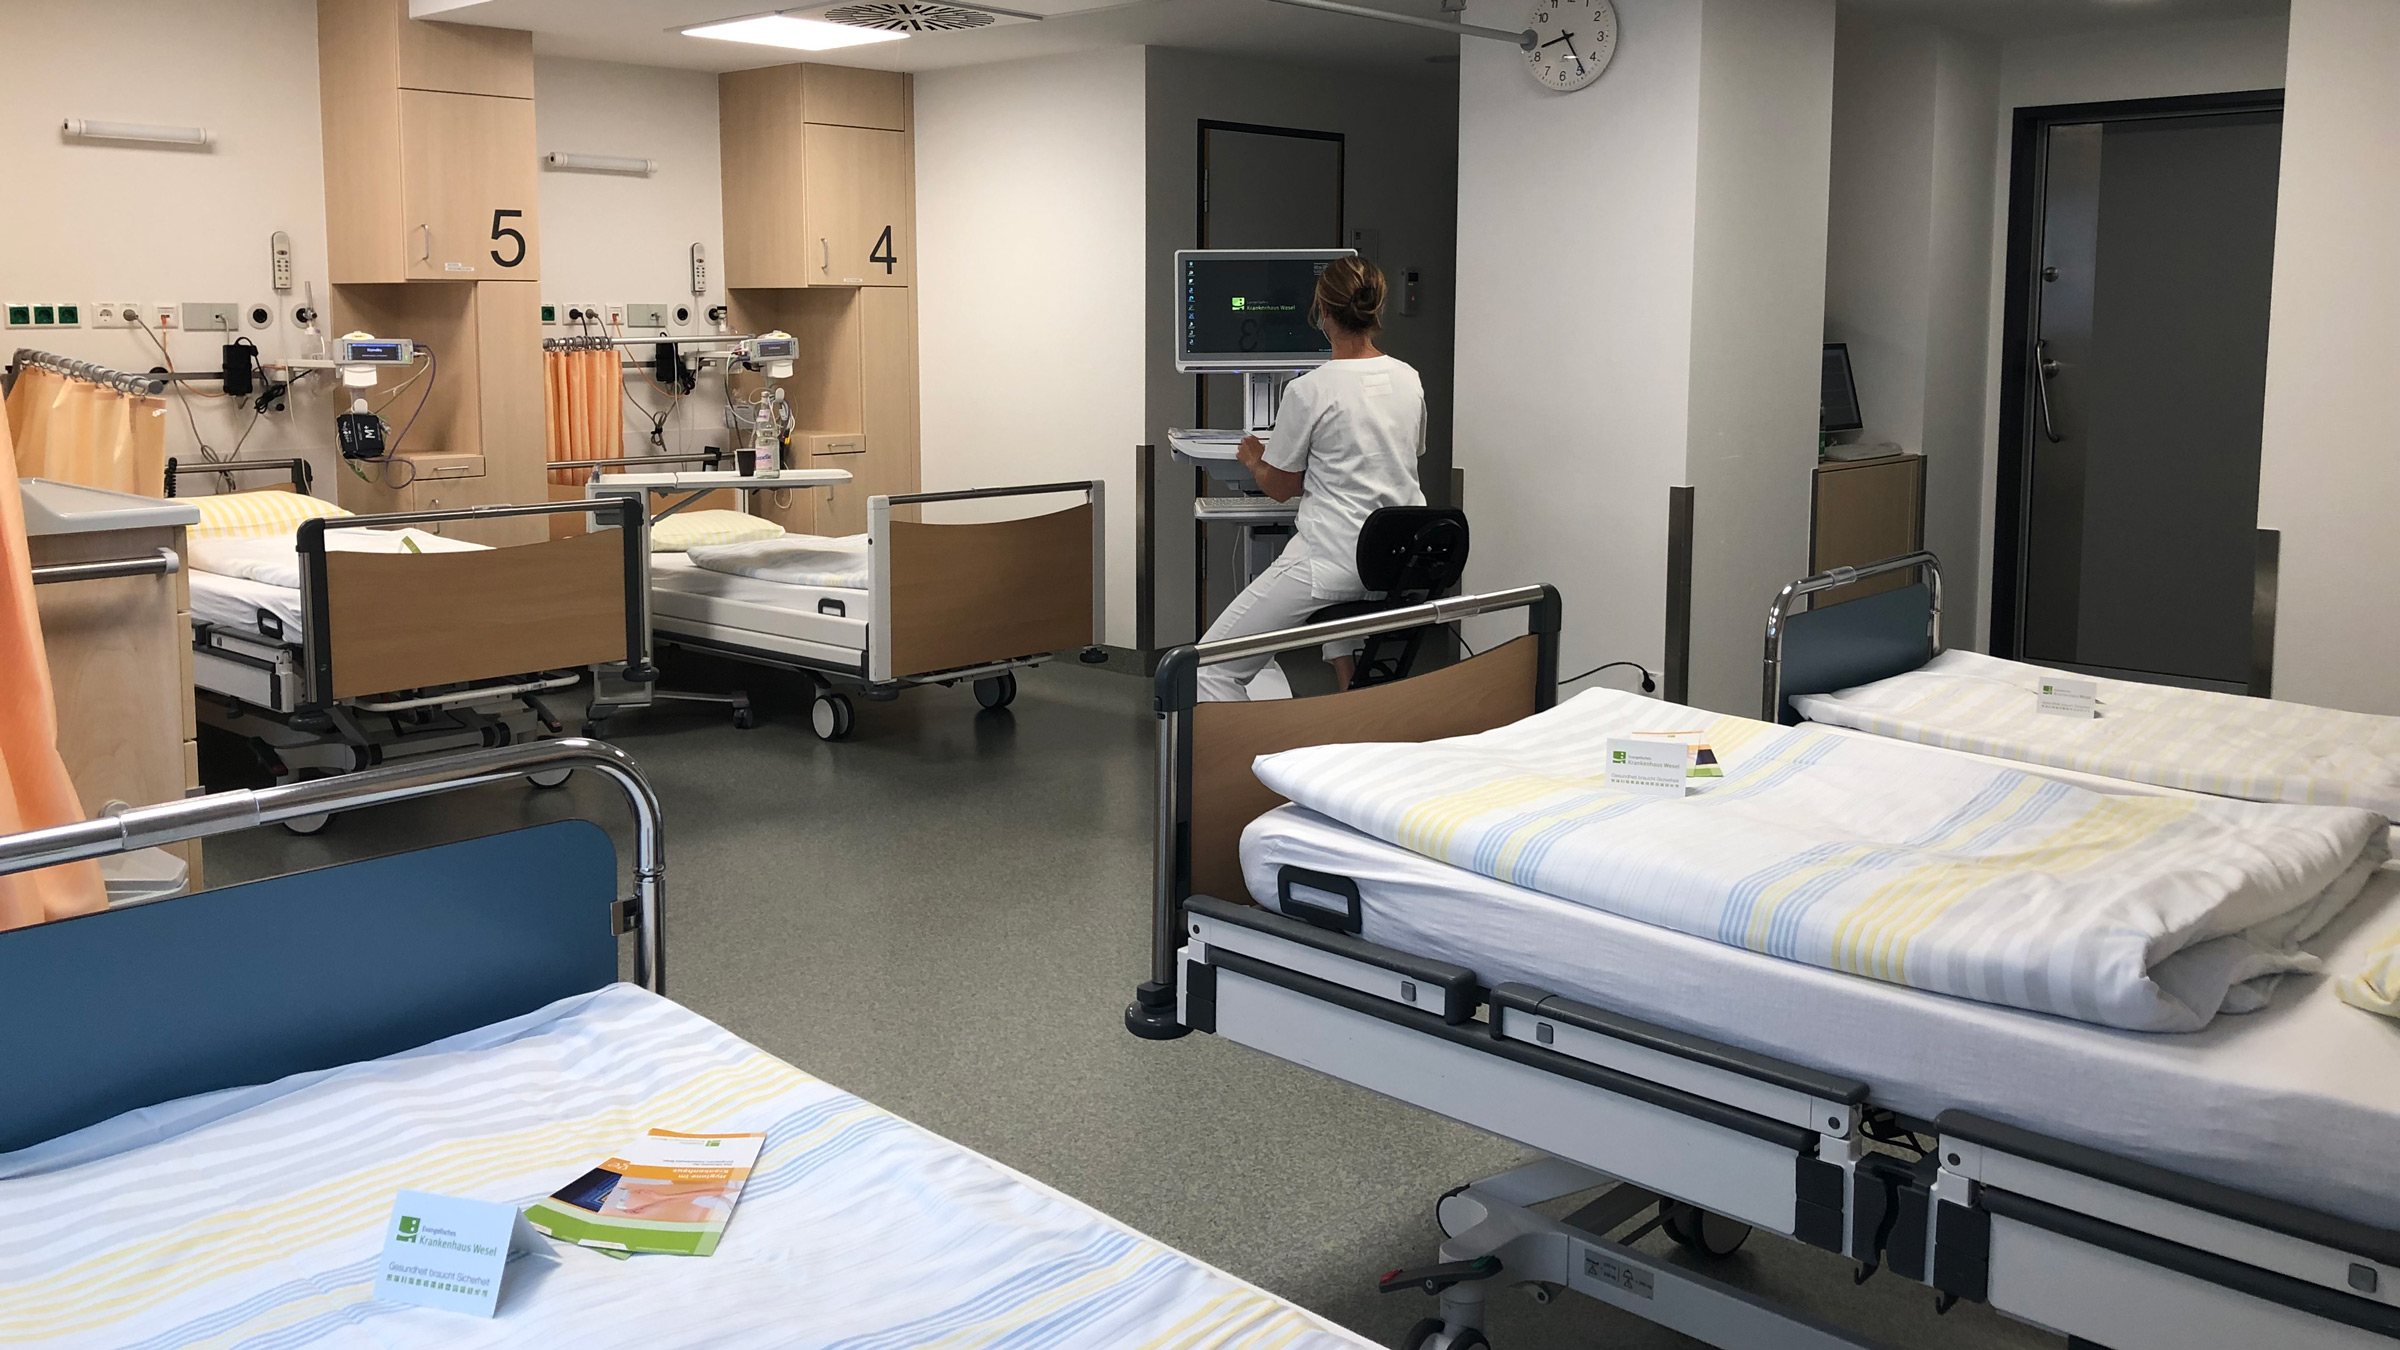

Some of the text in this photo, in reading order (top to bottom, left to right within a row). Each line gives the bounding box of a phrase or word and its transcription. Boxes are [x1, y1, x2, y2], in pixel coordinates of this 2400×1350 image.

[1538, 12, 1548, 23] 10
[1593, 11, 1601, 21] 2
[1597, 31, 1604, 41] 3
[1534, 52, 1541, 62] 8
[1590, 51, 1596, 61] 4
[1545, 66, 1551, 76] 7
[1559, 71, 1566, 81] 6
[1576, 66, 1583, 76] 5
[490, 208, 526, 268] 5
[869, 225, 897, 275] 4
[1627, 760, 1662, 768] Krankenhaus
[422, 1226, 456, 1236] Evangelisches
[419, 1235, 497, 1256] Krankenhaus Wesel
[388, 1261, 490, 1286] Gesundheit braucht Sicherheit
